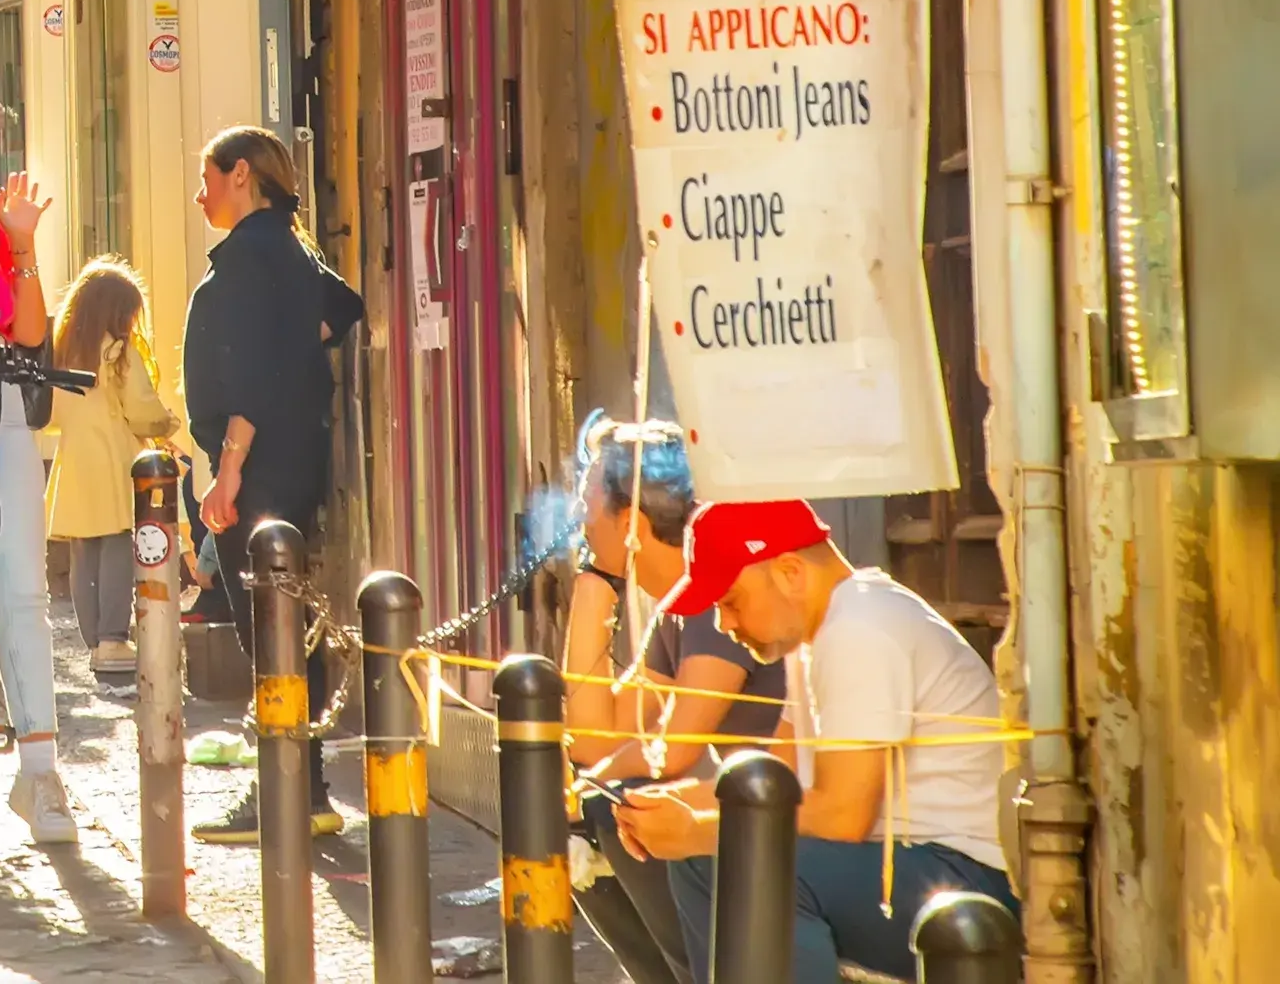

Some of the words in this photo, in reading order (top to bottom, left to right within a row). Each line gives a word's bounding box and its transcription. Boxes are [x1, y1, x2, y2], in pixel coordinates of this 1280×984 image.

[643, 12, 668, 55] SI
[688, 2, 871, 53] APPLICANO:
[672, 62, 783, 134] Bottoni
[793, 65, 871, 140] Jeans
[681, 173, 786, 263] Ciappe
[691, 274, 838, 350] Cerchietti
